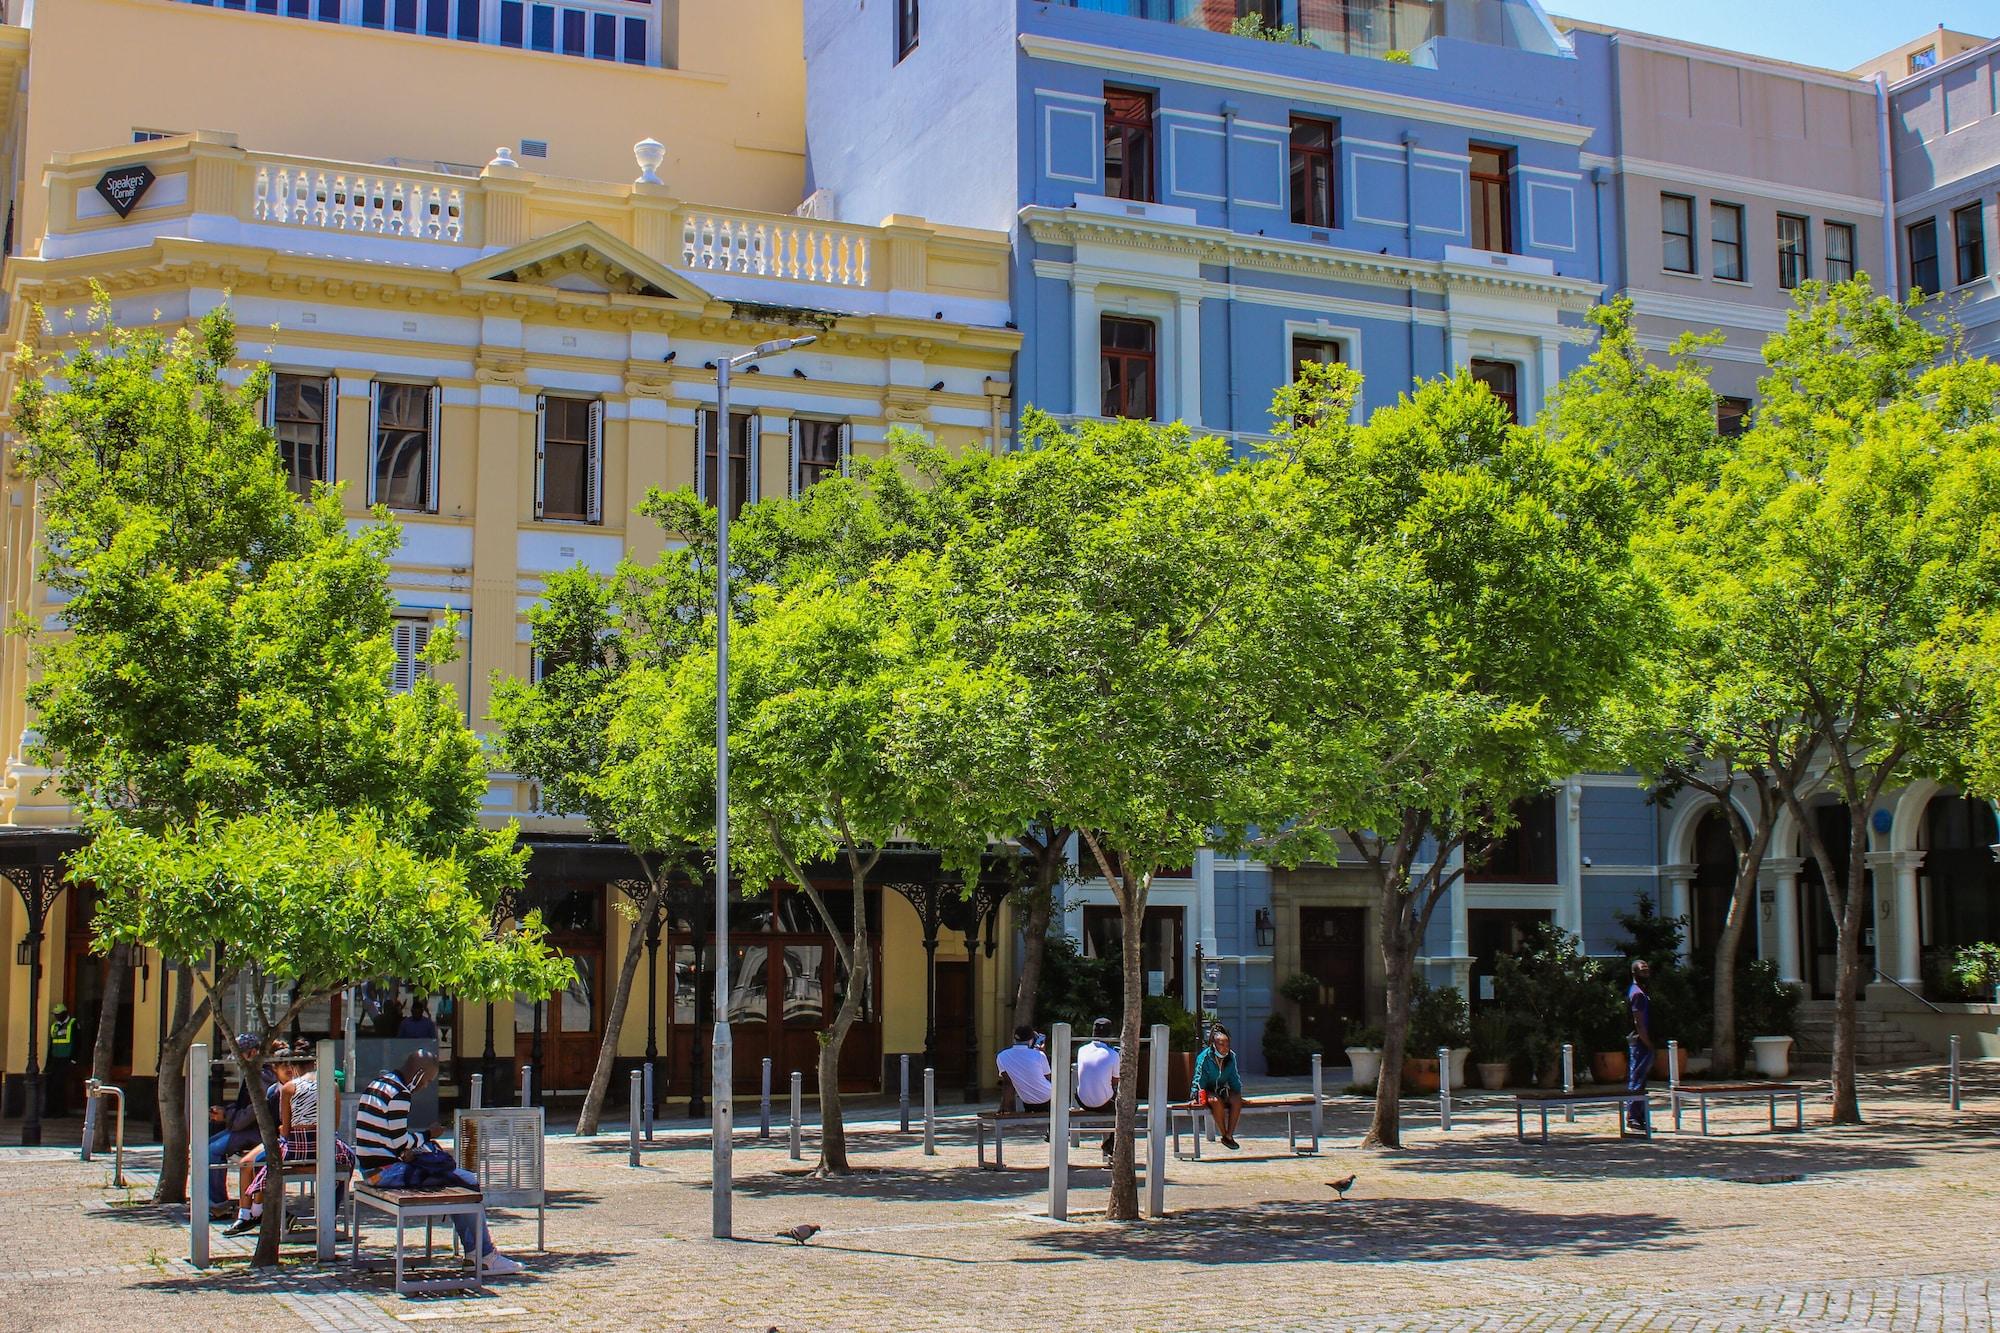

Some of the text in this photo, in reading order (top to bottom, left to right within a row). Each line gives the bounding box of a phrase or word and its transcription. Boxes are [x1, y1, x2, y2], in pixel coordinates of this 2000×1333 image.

[107, 173, 145, 195] Speakers'
[114, 186, 136, 199] Corner
[1764, 904, 1772, 923] 9
[1881, 900, 1890, 920] 9
